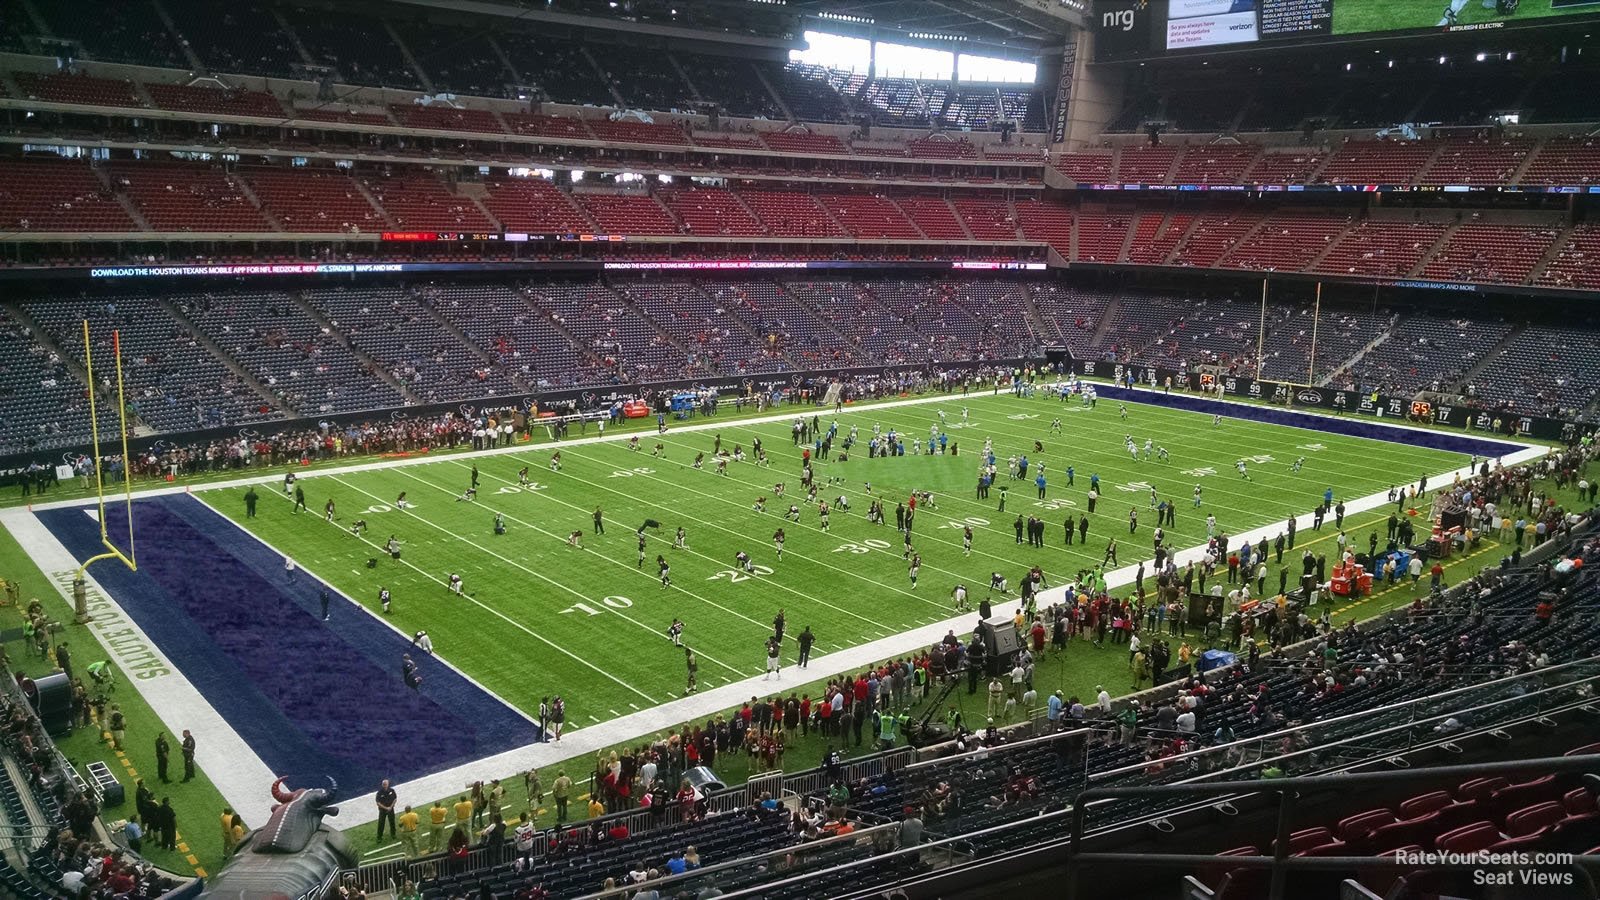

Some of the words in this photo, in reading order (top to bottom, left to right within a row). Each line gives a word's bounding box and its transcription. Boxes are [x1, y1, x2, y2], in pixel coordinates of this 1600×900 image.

[1103, 9, 1134, 31] nrg
[91, 269, 134, 277] DOWNLOAD
[149, 267, 182, 275] HOUSTON
[208, 266, 232, 274] MOBILE
[329, 264, 354, 272] STADIUM
[356, 264, 372, 272] MAPS
[1084, 364, 1095, 373] 95
[1225, 381, 1236, 390] 90
[1249, 384, 1260, 393] 99
[1275, 387, 1286, 396] 24
[1360, 399, 1372, 409] 25
[1388, 402, 1400, 413] 75
[1413, 403, 1427, 414] 25
[1438, 411, 1449, 420] 17
[1521, 421, 1530, 431] 11
[840, 539, 891, 554] 30
[715, 565, 774, 582] 20
[570, 596, 632, 616] 10
[94, 612, 126, 630] TO
[102, 628, 171, 680] SALUTE
[521, 830, 532, 843] 99
